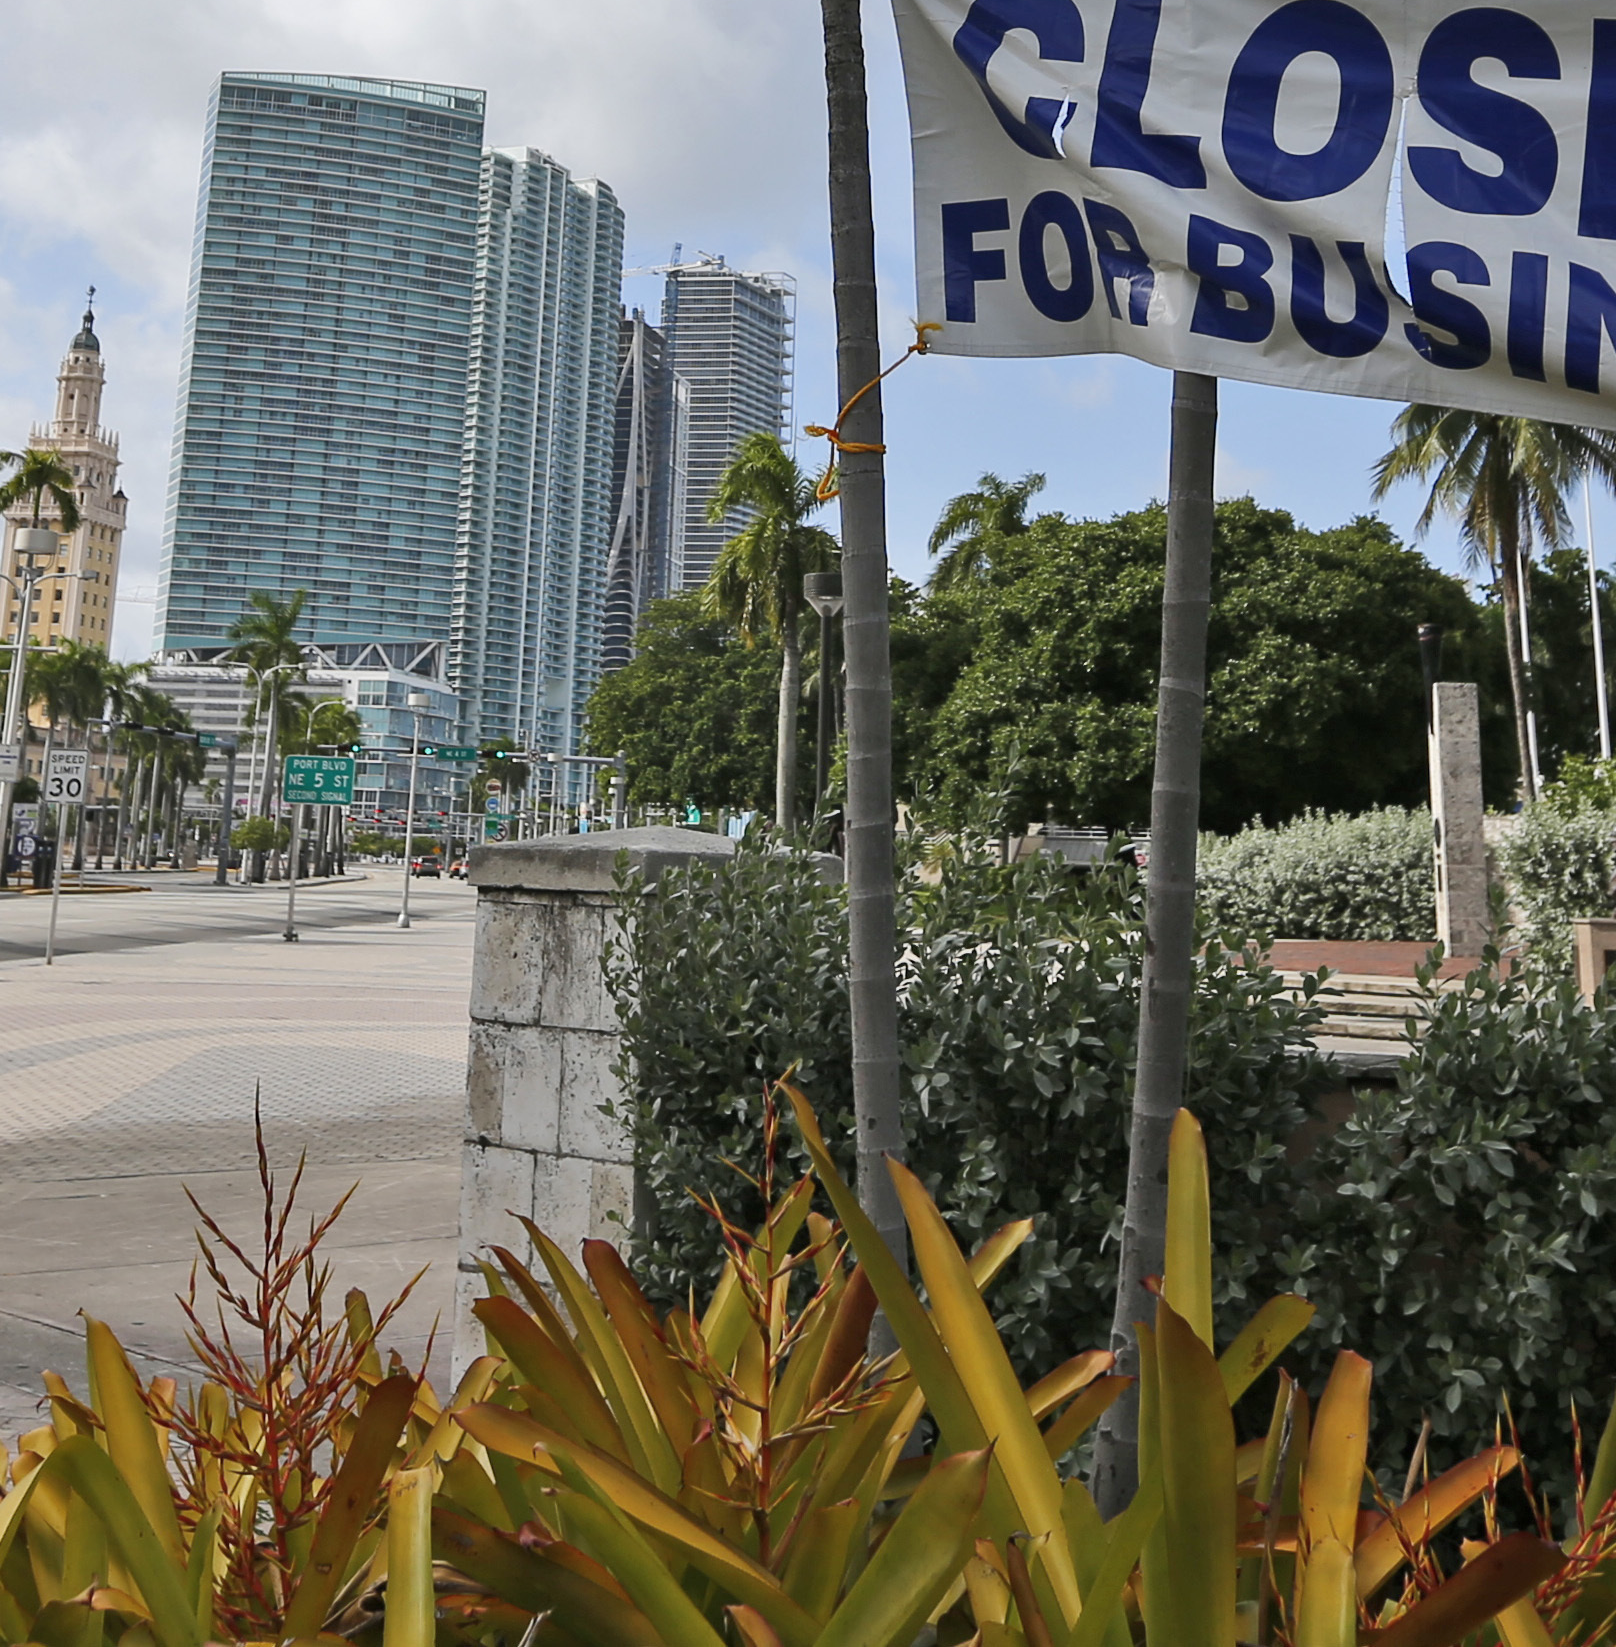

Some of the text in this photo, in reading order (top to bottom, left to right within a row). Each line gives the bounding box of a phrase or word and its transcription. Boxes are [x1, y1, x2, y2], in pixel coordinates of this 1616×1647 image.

[941, 190, 1155, 327] FOR
[51, 754, 85, 765] SPEED
[293, 759, 347, 771] PORT BLVD
[53, 766, 80, 775] LIMIT
[288, 773, 350, 788] NE 5 ST
[49, 777, 82, 797] 30
[320, 792, 348, 802] SIGNAL
